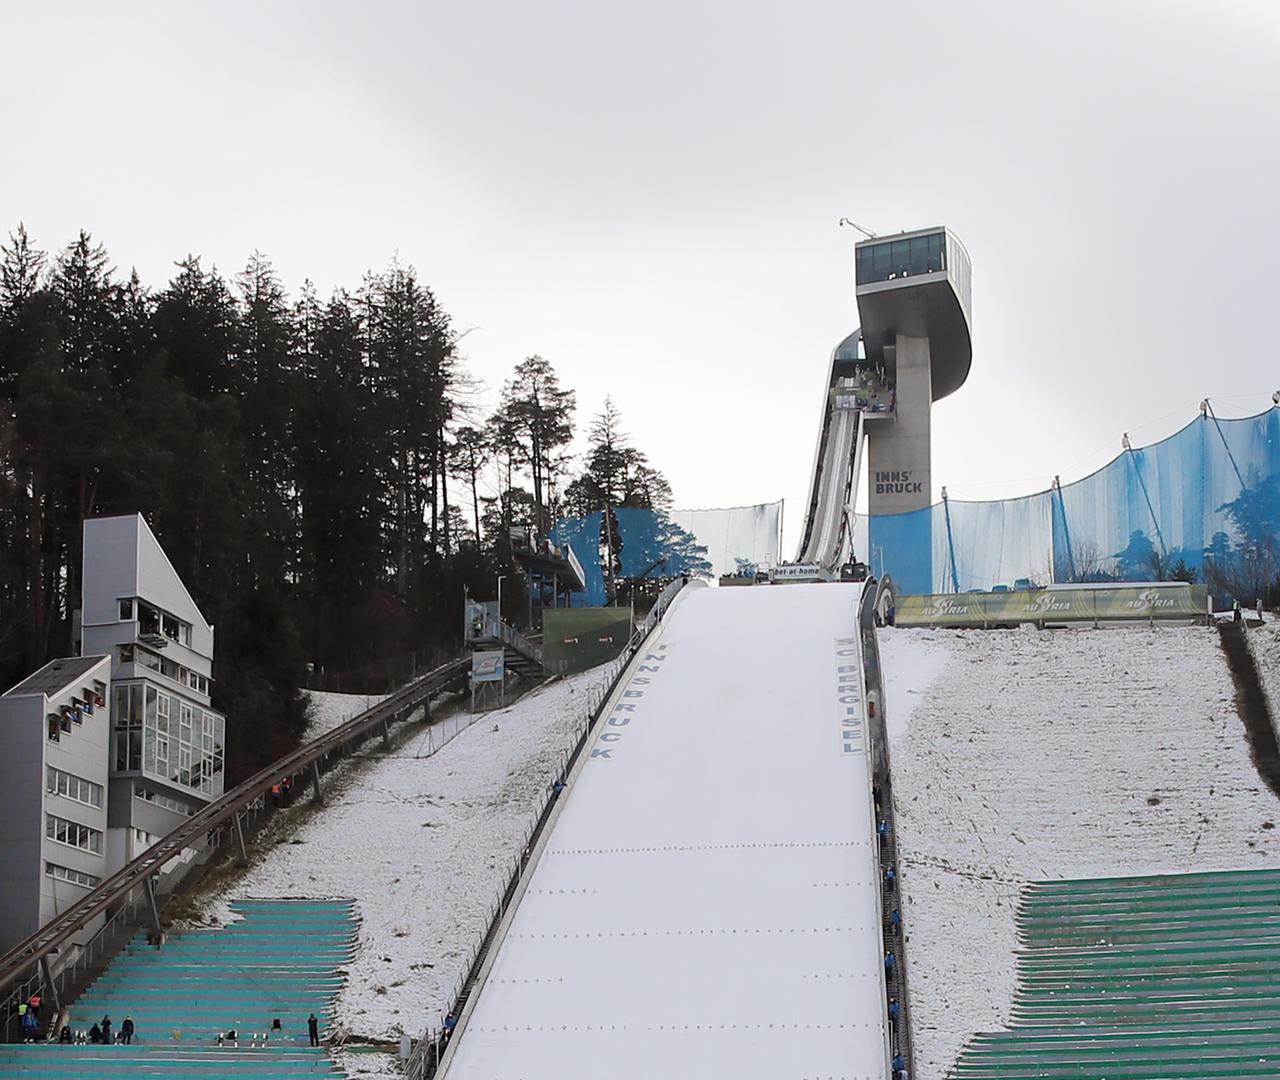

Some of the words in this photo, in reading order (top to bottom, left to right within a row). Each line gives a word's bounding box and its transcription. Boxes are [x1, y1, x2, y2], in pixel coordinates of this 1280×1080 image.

[876, 482, 922, 494] BRUCK
[774, 568, 819, 576] bet-at-home
[590, 645, 667, 758] INNSBRUCK
